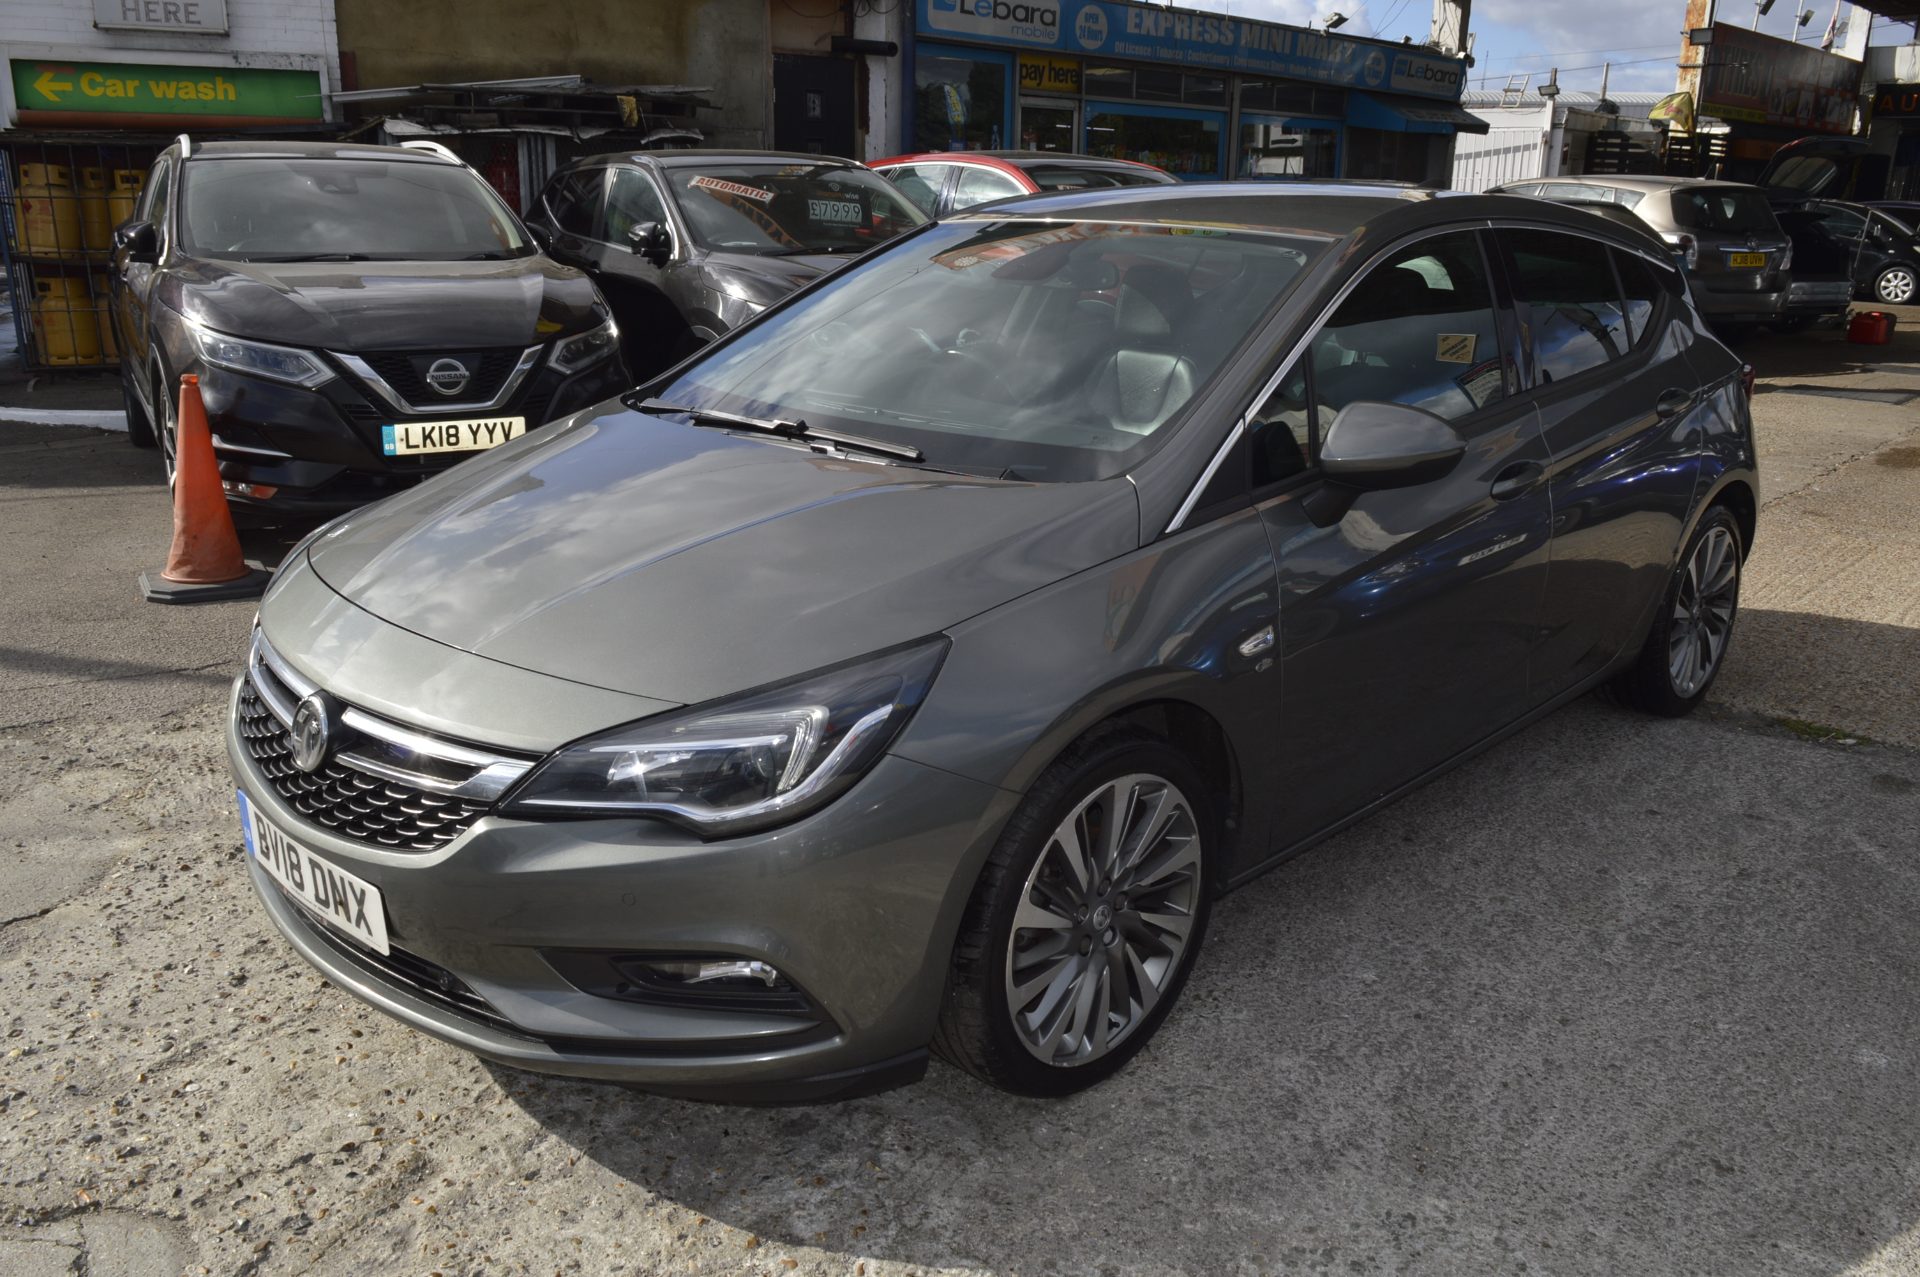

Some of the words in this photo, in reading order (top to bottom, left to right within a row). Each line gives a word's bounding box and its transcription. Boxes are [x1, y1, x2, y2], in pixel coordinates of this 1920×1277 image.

[121, 0, 202, 26] HERE
[959, 0, 1057, 27] Lebara
[1084, 12, 1100, 25] OPEN
[1010, 23, 1057, 40] mobile
[1126, 6, 1234, 47] EXPRESS
[1240, 22, 1293, 55] MINI
[1296, 32, 1357, 65] MART
[1020, 61, 1046, 88] pay
[1047, 59, 1079, 85] here
[1406, 60, 1459, 85] Lebara
[79, 71, 140, 98] Car
[148, 76, 237, 102] wash
[695, 177, 769, 200] AUTOMATIC
[811, 202, 861, 219] £7999
[431, 373, 466, 382] NISSAN
[405, 424, 460, 449] LK18
[467, 421, 513, 445] YYV
[253, 811, 305, 892] BV18
[308, 856, 374, 937] DNX
